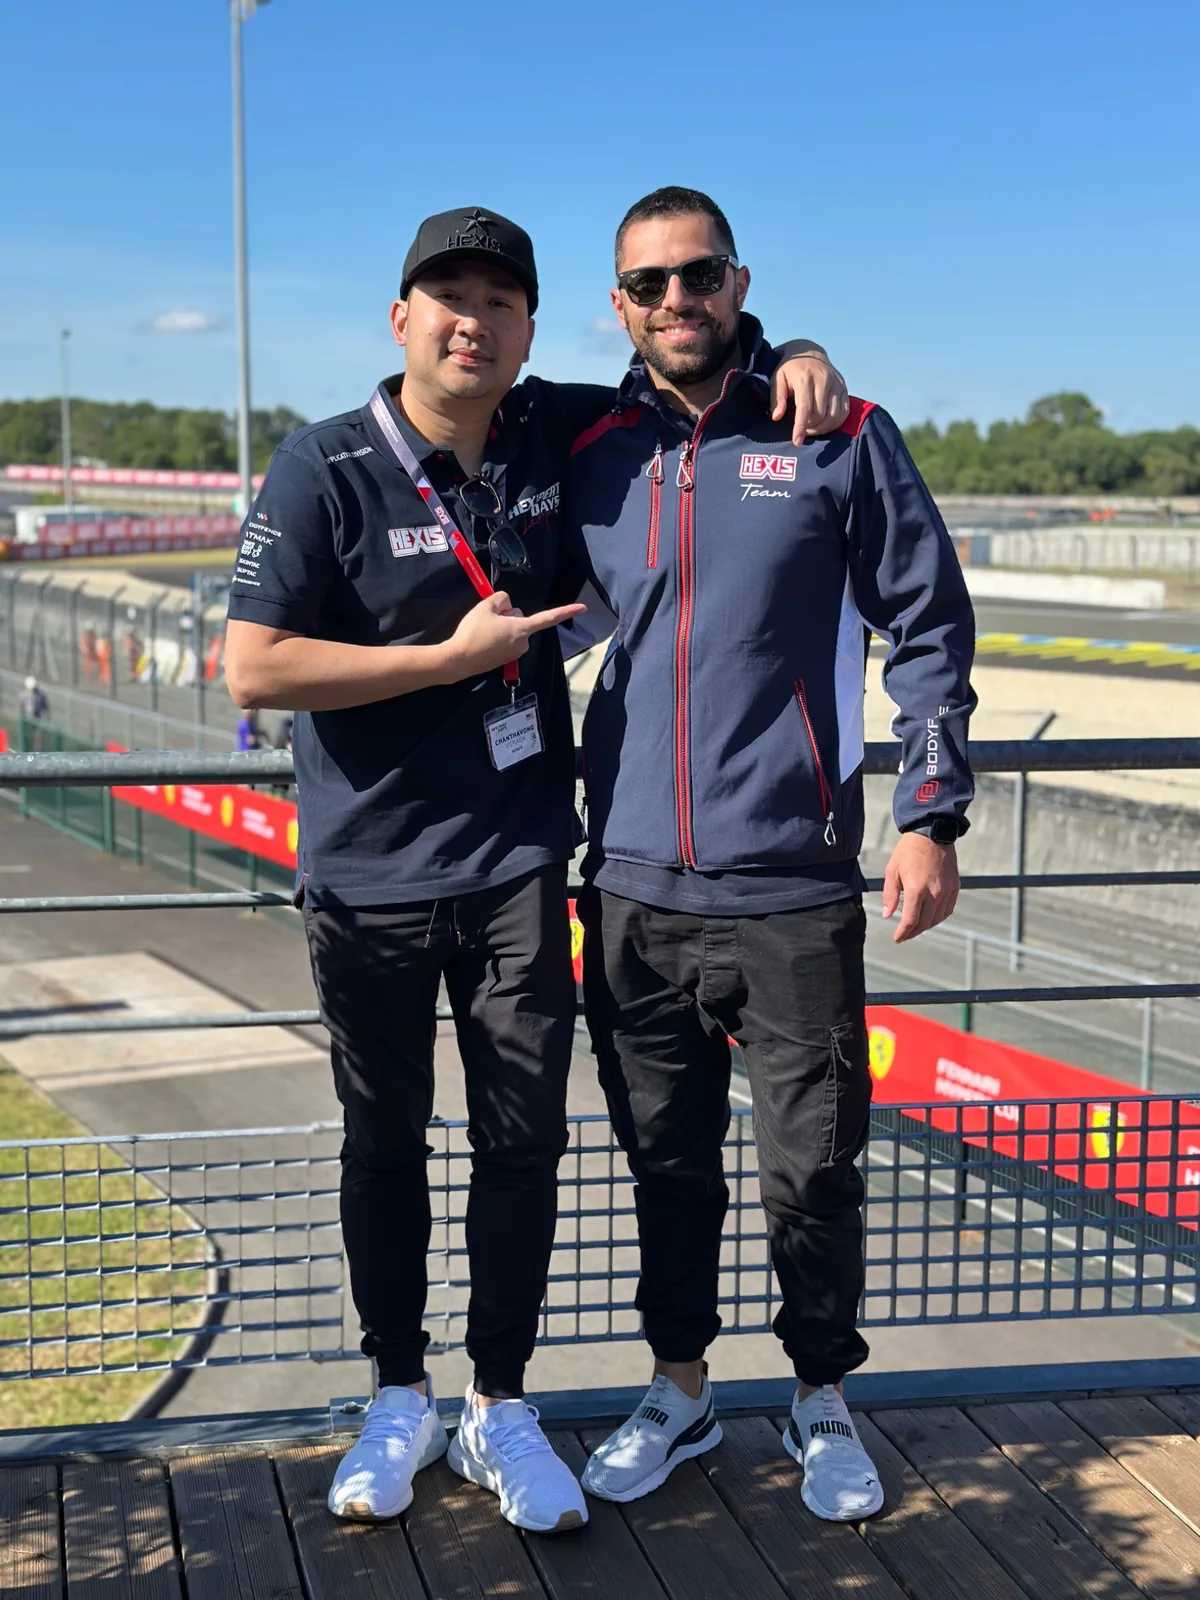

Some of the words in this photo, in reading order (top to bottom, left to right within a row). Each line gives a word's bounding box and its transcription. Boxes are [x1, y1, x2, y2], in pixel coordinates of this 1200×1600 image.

[446, 234, 502, 252] HEXIS
[741, 455, 796, 479] HEXIS
[740, 483, 791, 501] Team
[531, 496, 560, 517] DAYS
[389, 526, 447, 554] HEXIS
[810, 1419, 853, 1440] PUMA
